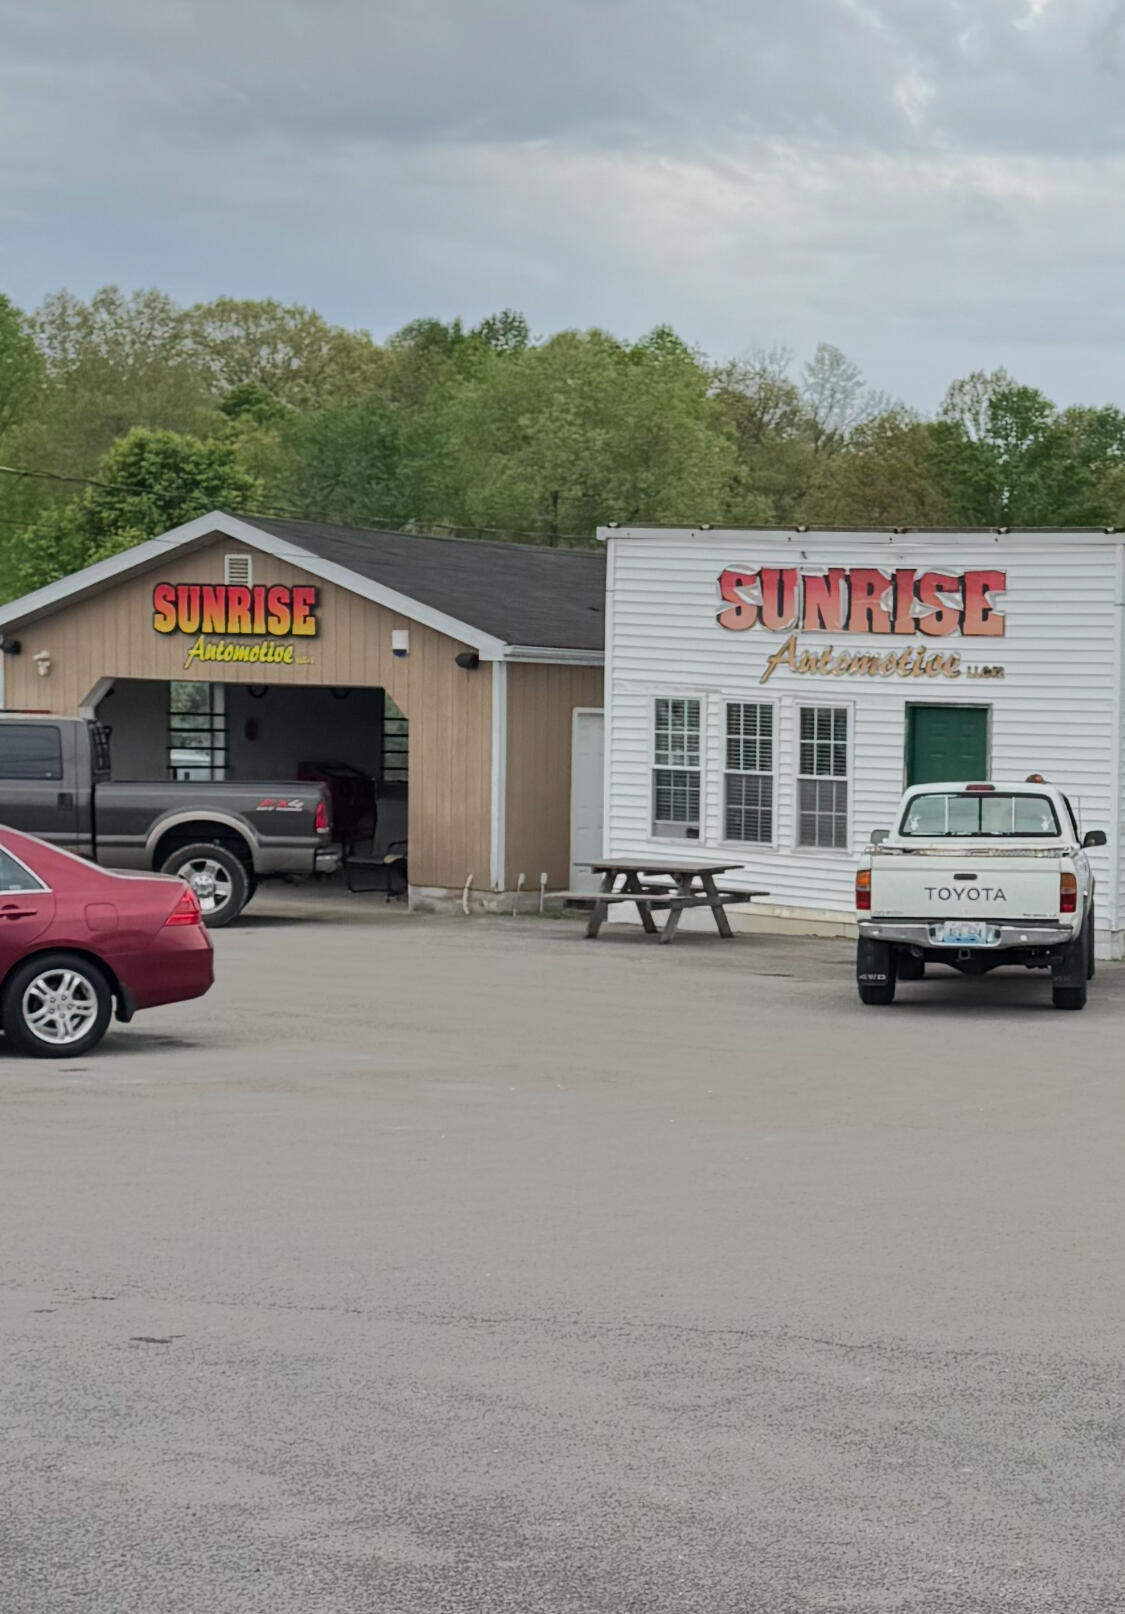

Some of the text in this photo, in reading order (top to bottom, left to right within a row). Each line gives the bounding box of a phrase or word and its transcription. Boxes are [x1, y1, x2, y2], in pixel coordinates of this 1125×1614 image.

[153, 583, 317, 637] SUNRISE
[716, 566, 1007, 637] SUNRISE
[184, 634, 293, 670] Automotive
[760, 634, 961, 685] Automotive
[924, 886, 1007, 902] TOYOTA
